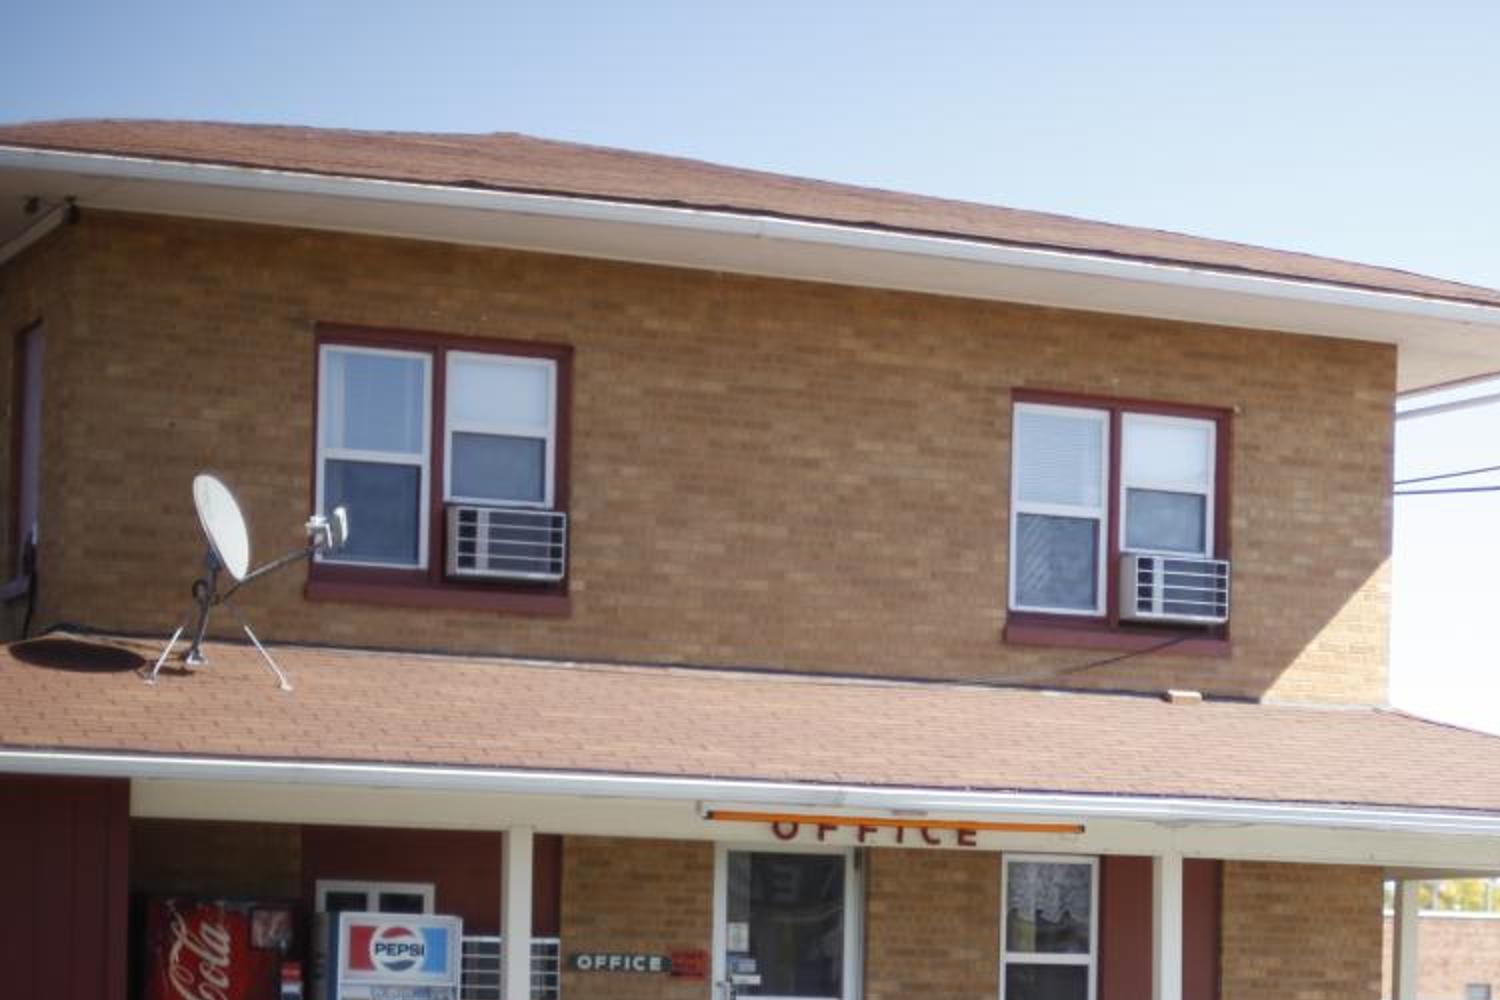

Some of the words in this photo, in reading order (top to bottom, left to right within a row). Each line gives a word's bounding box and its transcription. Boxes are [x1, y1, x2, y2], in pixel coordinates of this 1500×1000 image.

[771, 820, 978, 846] OFFICE
[374, 942, 425, 957] PEPSI
[576, 954, 664, 972] OFFICE
